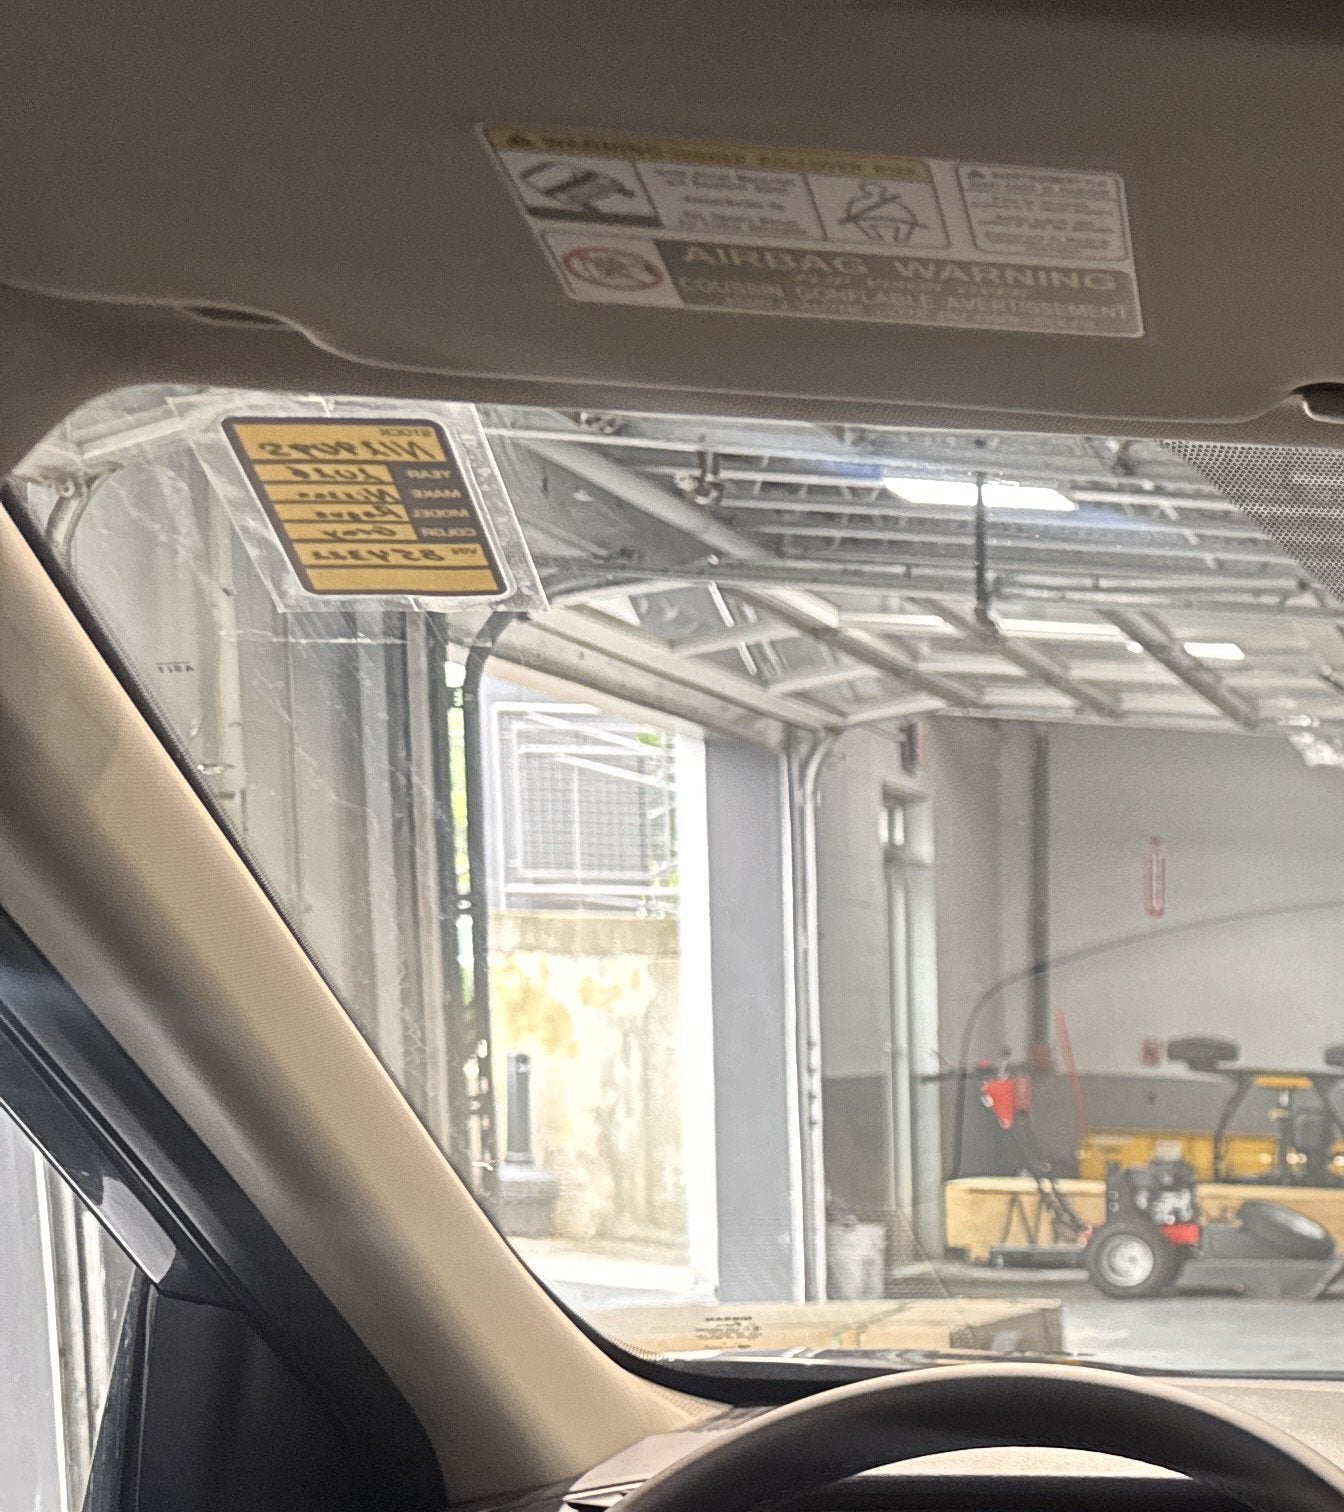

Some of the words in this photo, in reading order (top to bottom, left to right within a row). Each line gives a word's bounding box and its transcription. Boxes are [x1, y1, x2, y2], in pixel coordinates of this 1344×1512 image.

[683, 245, 868, 276] AIRBAG
[894, 259, 1117, 292] WARNING
[679, 276, 784, 298] COUSSIN
[797, 285, 931, 307] GONFLABLE
[946, 296, 1129, 320] AVERTISSEMENT
